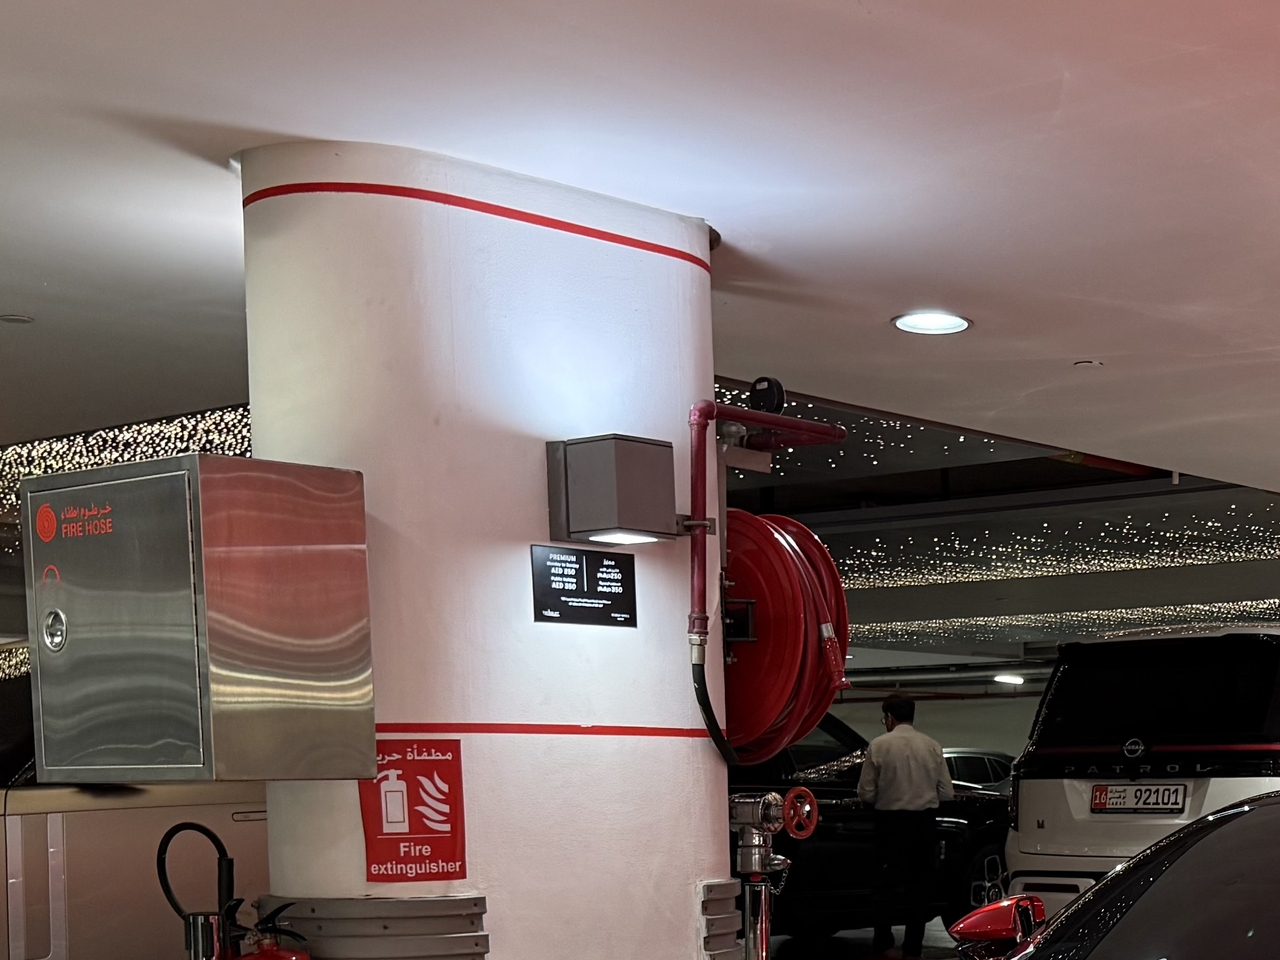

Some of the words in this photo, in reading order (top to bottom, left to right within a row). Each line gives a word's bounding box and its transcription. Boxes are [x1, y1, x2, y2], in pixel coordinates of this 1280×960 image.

[61, 522, 83, 538] FIRE
[85, 519, 113, 535] HOSE
[376, 752, 402, 764] حري
[406, 744, 453, 761] مطفأة
[1065, 764, 1207, 773] PATROL
[1094, 791, 1107, 804] 16
[1134, 787, 1180, 806] 92101
[400, 842, 431, 857] Fire
[371, 859, 462, 877] extinguisher
